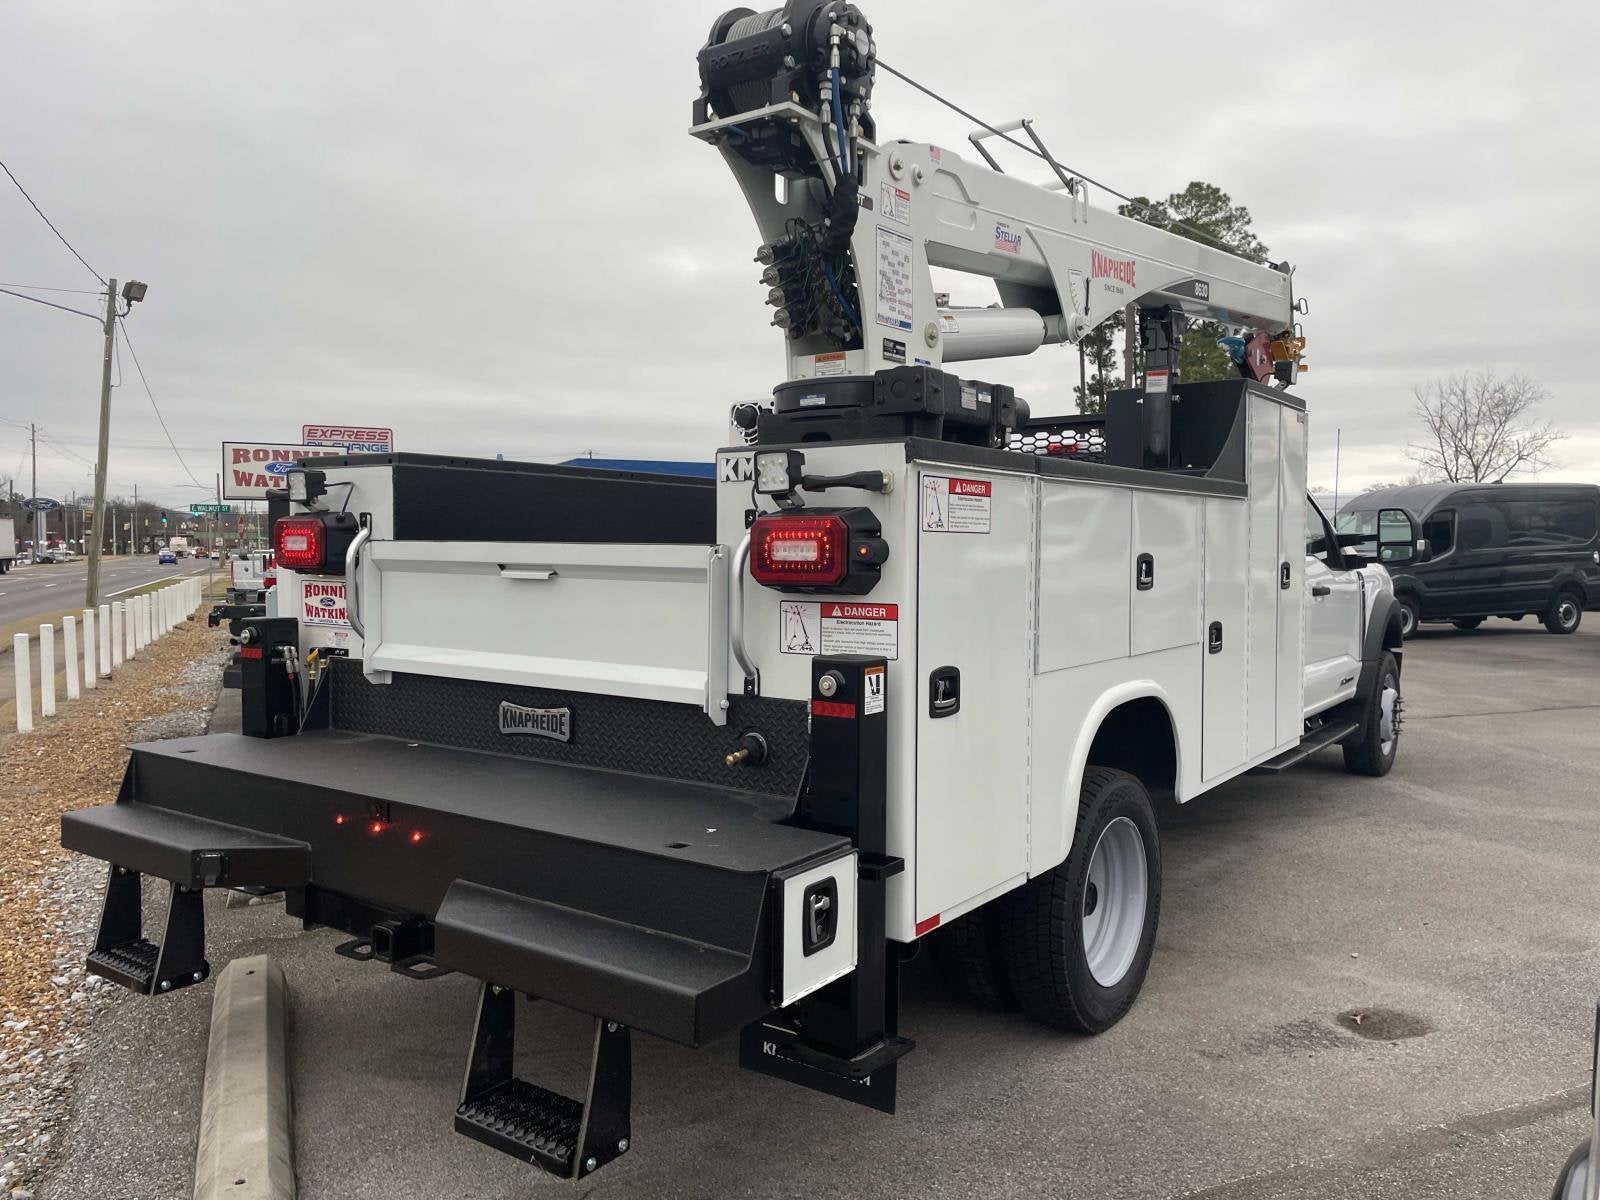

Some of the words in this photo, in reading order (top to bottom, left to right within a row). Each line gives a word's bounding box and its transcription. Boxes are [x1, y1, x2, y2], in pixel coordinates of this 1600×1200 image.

[995, 226, 1022, 247] STELLAR
[1091, 249, 1137, 288] KNAPHEIDE
[1194, 282, 1208, 298] 8630
[306, 428, 389, 441] EXPRESS
[962, 483, 986, 494] DANGER
[844, 606, 887, 617] DANGER
[502, 706, 566, 737] KNAPHEIDE
